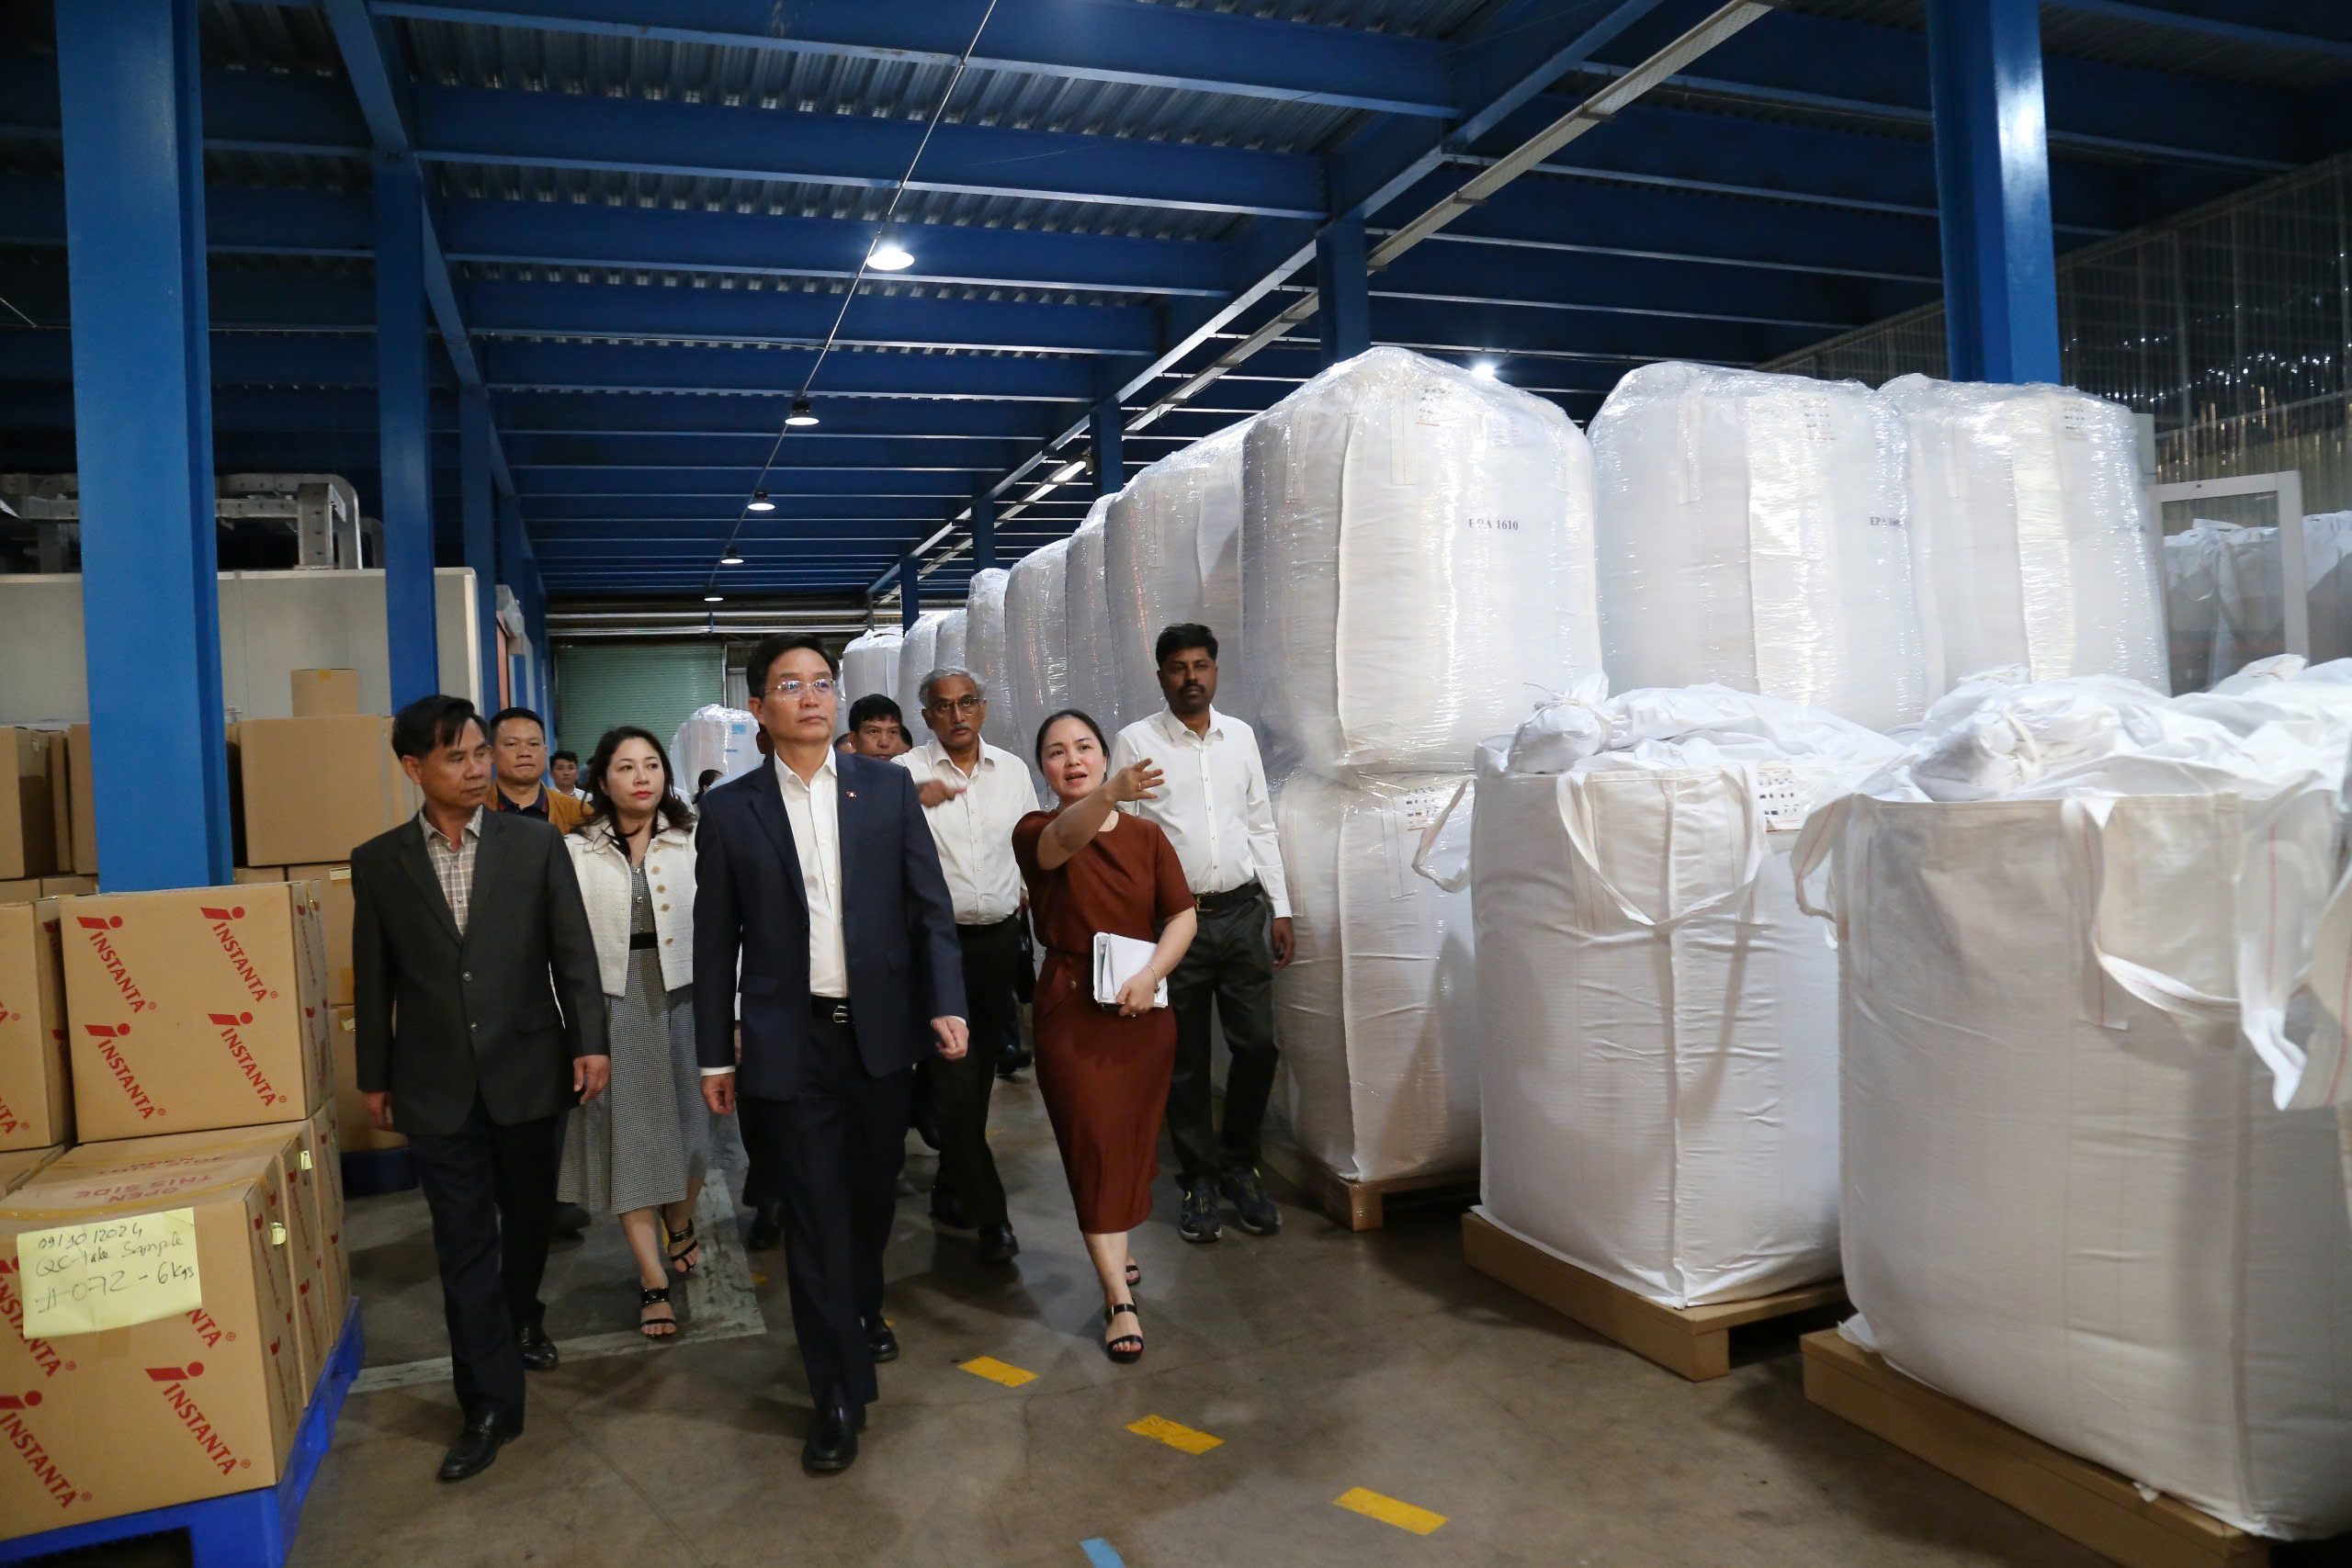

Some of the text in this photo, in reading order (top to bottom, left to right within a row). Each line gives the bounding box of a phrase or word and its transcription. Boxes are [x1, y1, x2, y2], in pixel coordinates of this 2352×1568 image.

[1496, 519, 1520, 531] 1610
[89, 931, 146, 1014] INSTANTA
[212, 921, 268, 1003] INSTANTA
[97, 1039, 155, 1121] INSTANTA
[220, 1028, 277, 1108] INSTANTA
[0, 1413, 77, 1509] INSTANTA
[163, 1382, 239, 1477] INSTANTA
